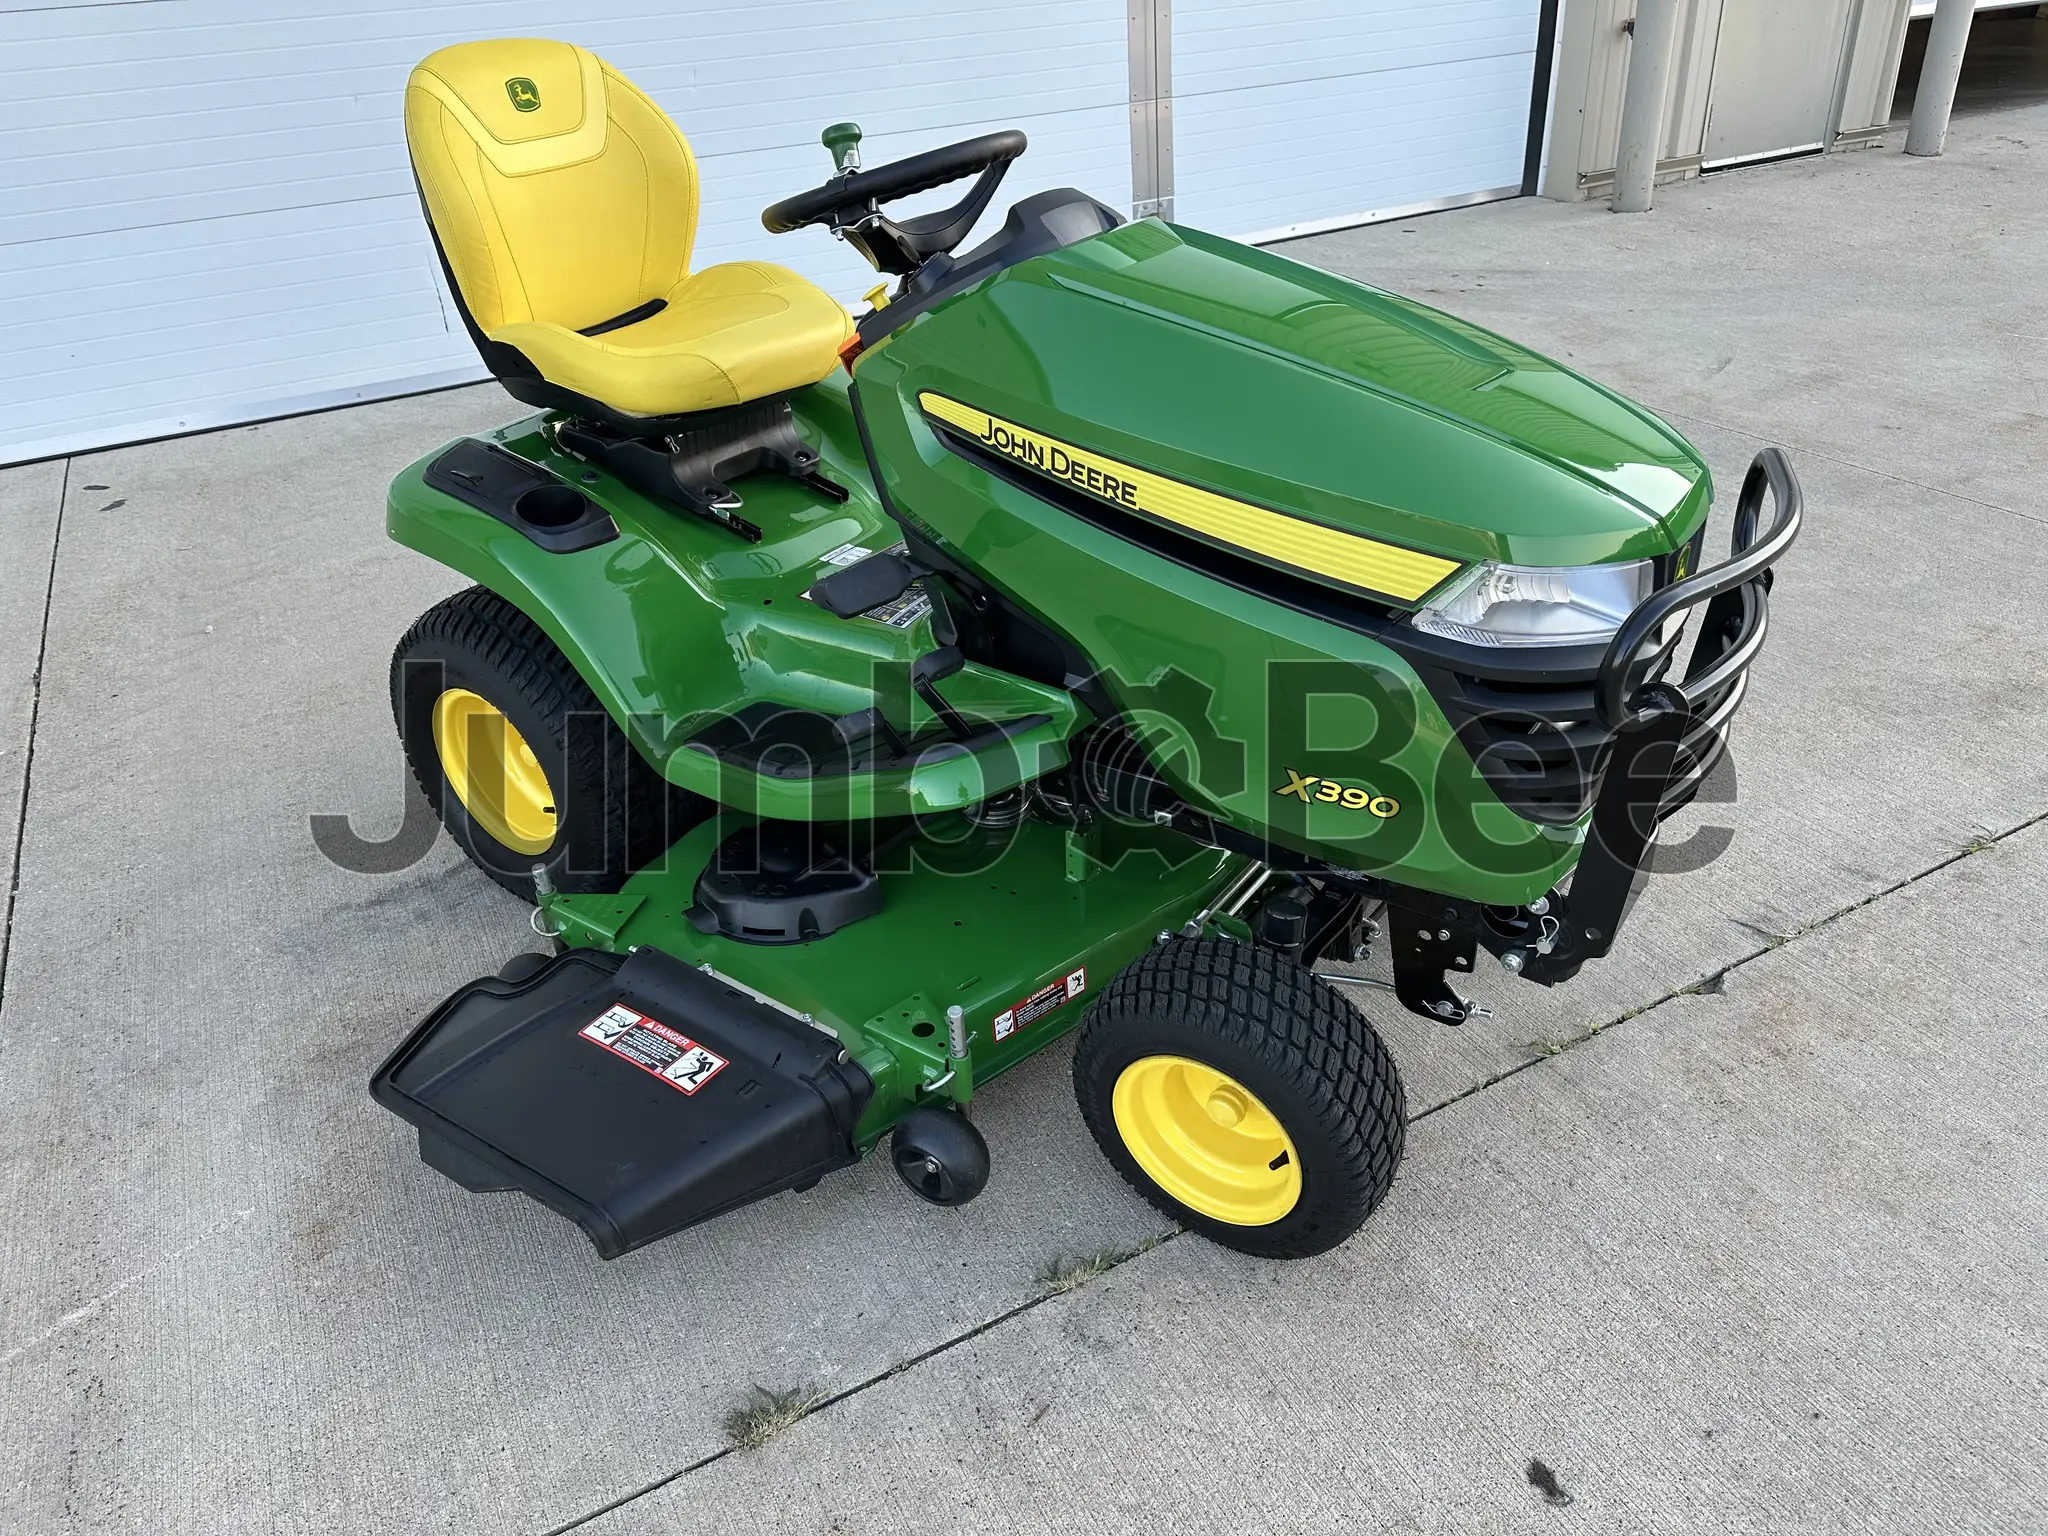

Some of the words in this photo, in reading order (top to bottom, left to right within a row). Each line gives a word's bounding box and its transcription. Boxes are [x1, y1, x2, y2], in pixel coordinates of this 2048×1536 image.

[980, 417, 1045, 468] JOHN
[1050, 446, 1138, 508] DEERE
[1272, 766, 1401, 819] X390
[1031, 983, 1055, 1001] DANGER
[653, 1024, 691, 1047] DANGER
